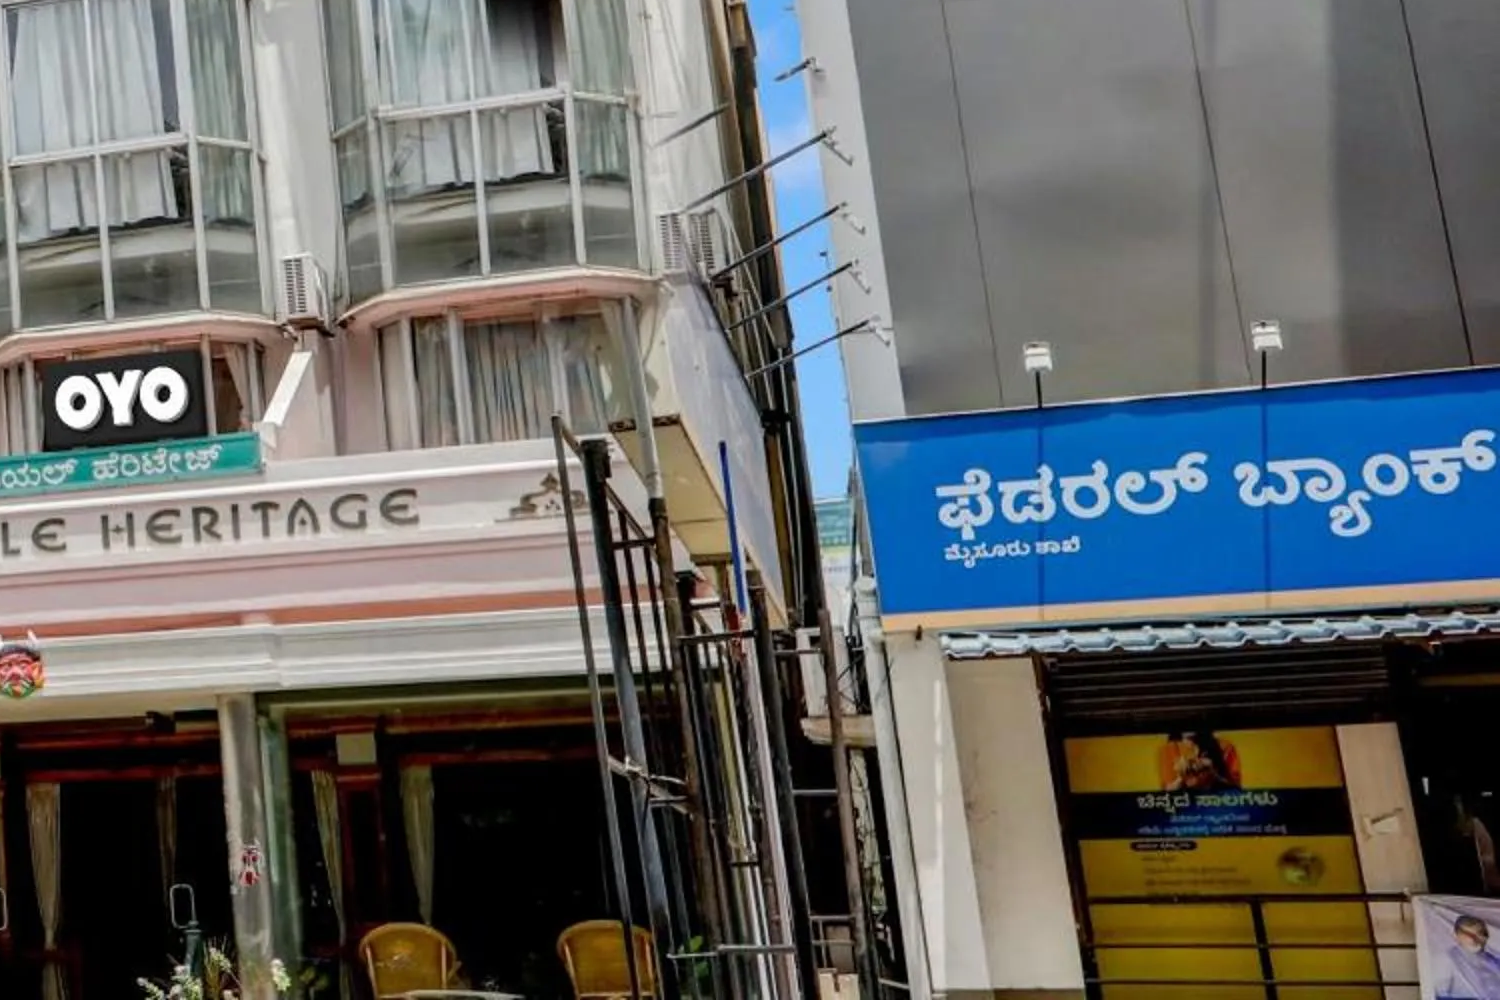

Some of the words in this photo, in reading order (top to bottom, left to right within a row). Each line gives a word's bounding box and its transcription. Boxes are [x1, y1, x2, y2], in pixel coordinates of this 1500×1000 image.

[55, 366, 190, 430] OYO
[935, 451, 1209, 541] ಫೆಡರಲ್
[1233, 429, 1497, 537] ಬ್ಯಾಂಕ್
[100, 488, 420, 551] HERITAGE
